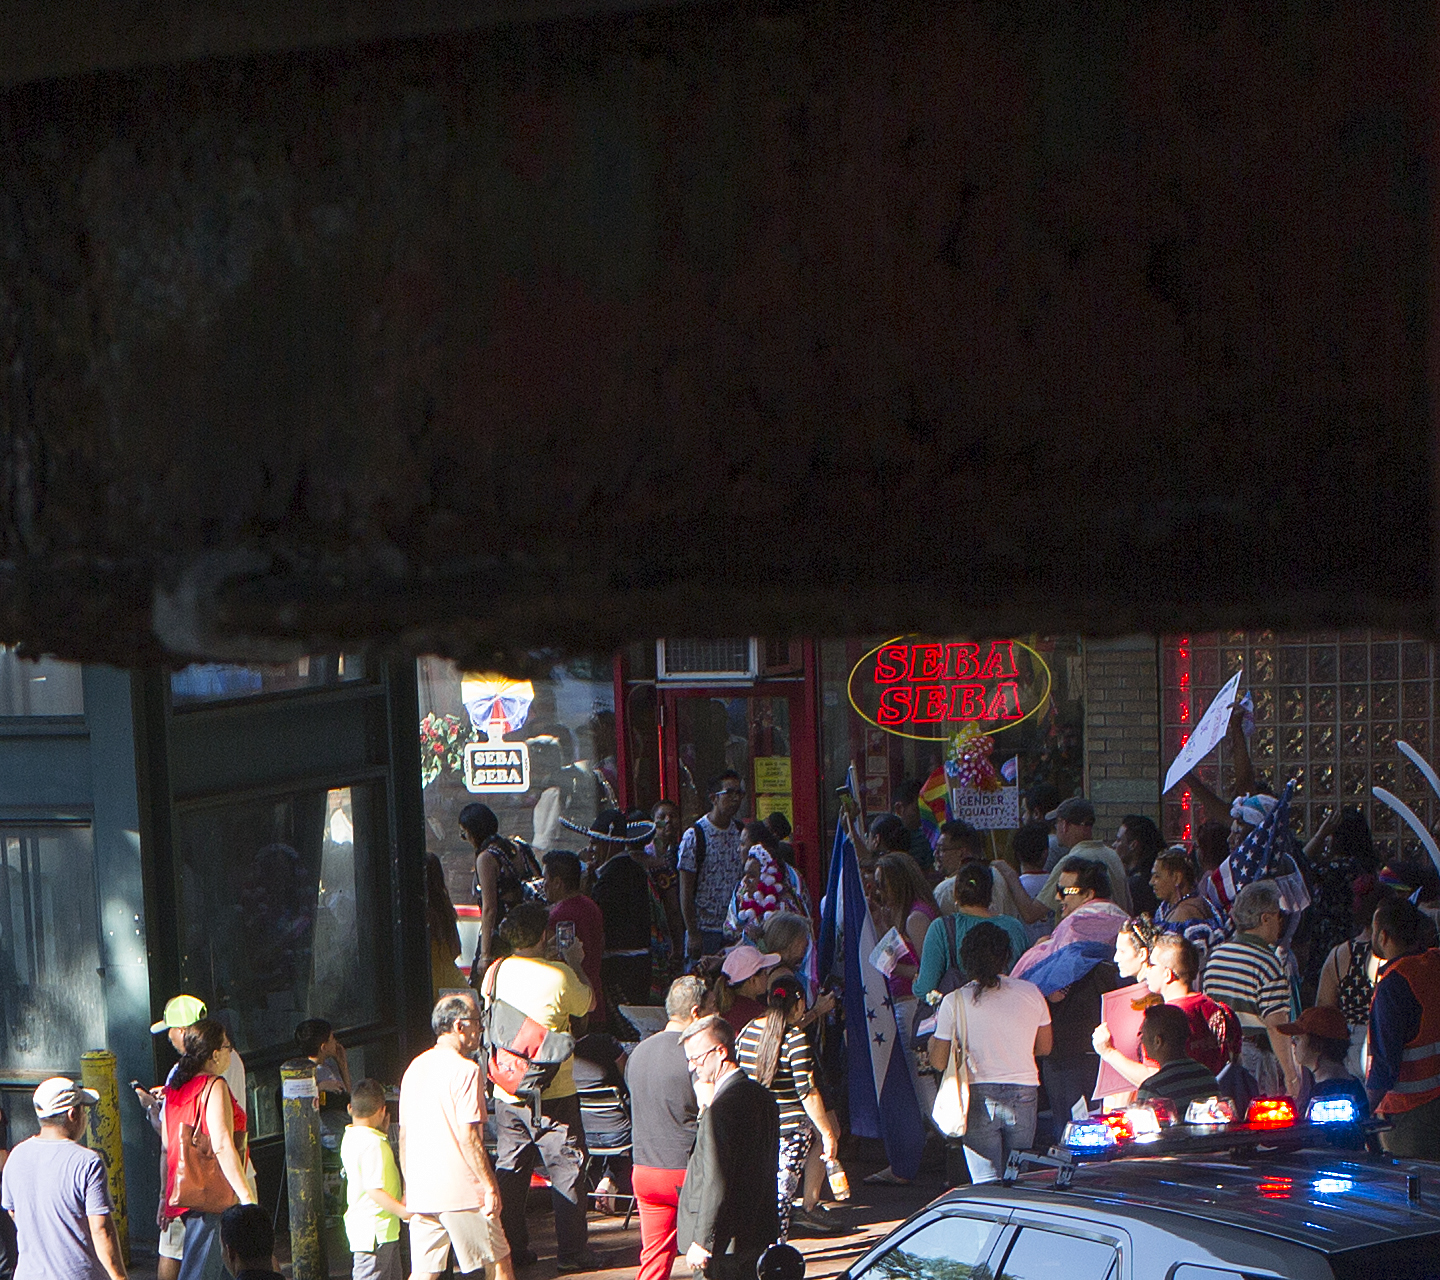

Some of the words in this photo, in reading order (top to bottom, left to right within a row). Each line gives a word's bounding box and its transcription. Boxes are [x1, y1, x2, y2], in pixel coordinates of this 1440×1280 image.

[874, 640, 1020, 684] SEBA
[877, 681, 1025, 725] SEBA
[474, 750, 521, 766] SEBA
[474, 768, 522, 784] SEBA
[958, 794, 1004, 806] GENDER
[958, 806, 1006, 817] EQUALITY
